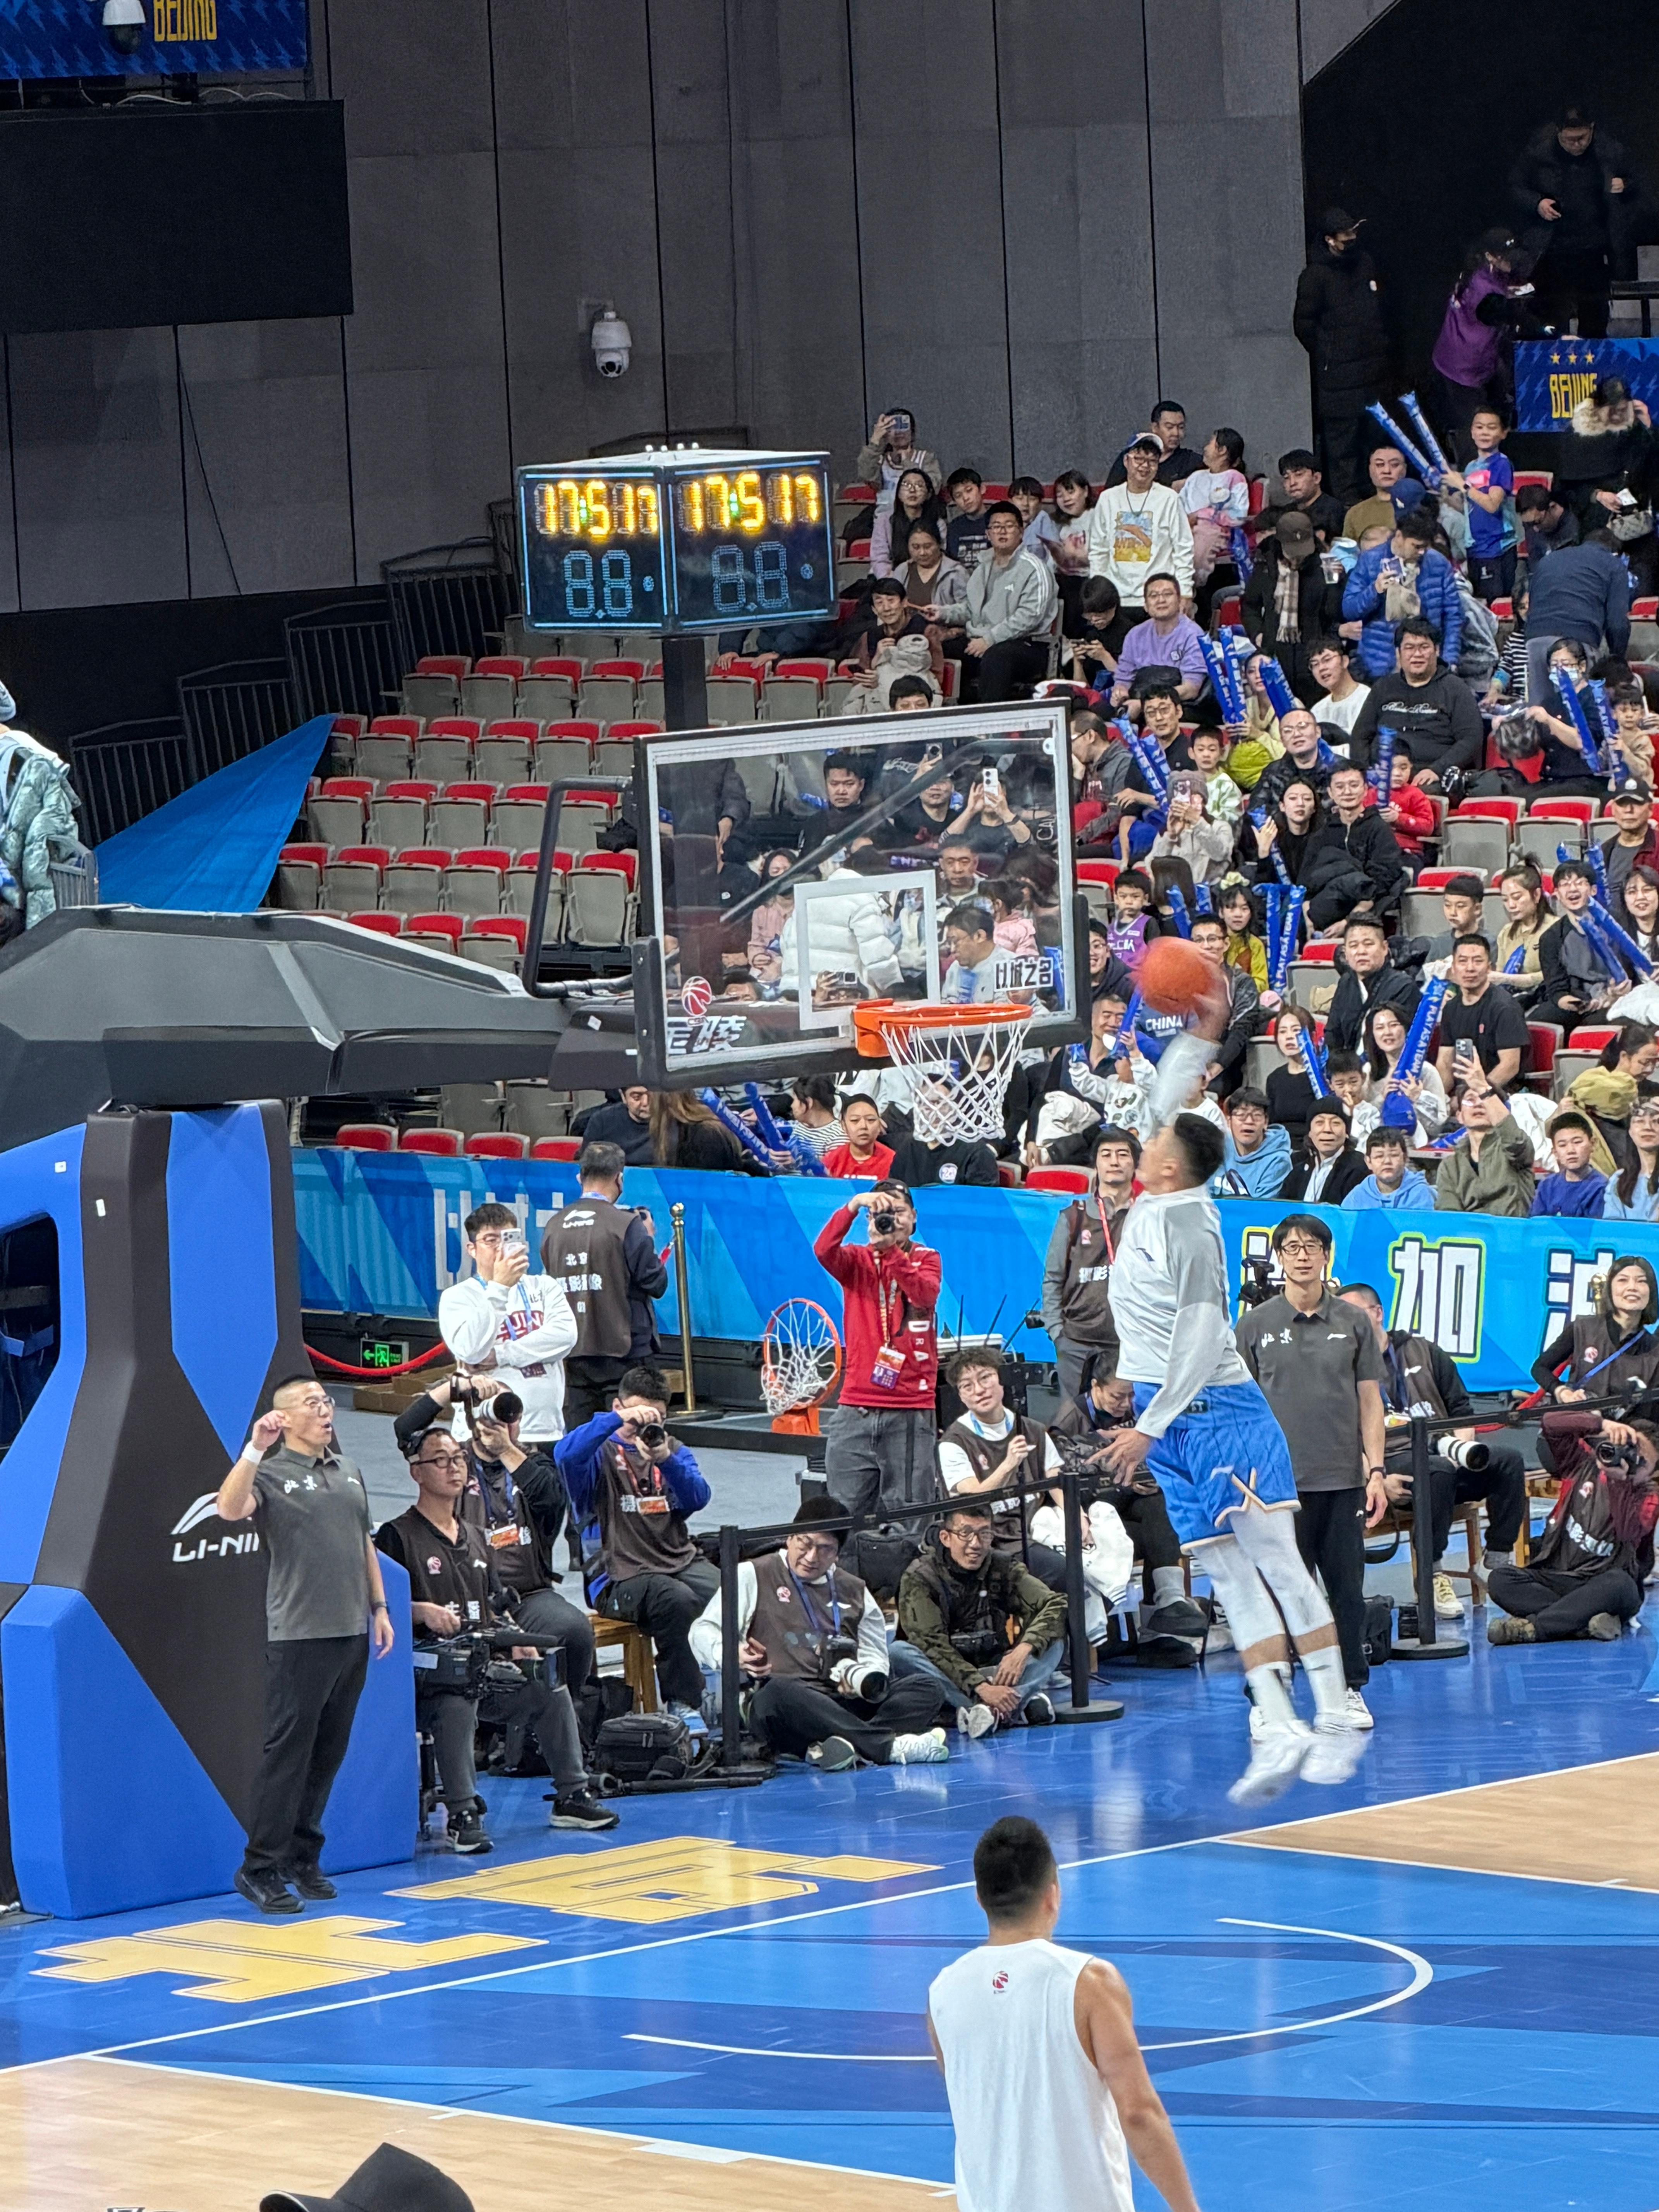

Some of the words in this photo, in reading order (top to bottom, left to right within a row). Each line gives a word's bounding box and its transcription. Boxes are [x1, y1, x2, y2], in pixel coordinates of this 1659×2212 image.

[1146, 1015, 1183, 1032] CHINA
[1424, 1005, 1438, 1028] PLAY
[1410, 1048, 1425, 1073] TEAM
[29, 1835, 945, 2003] 北京
